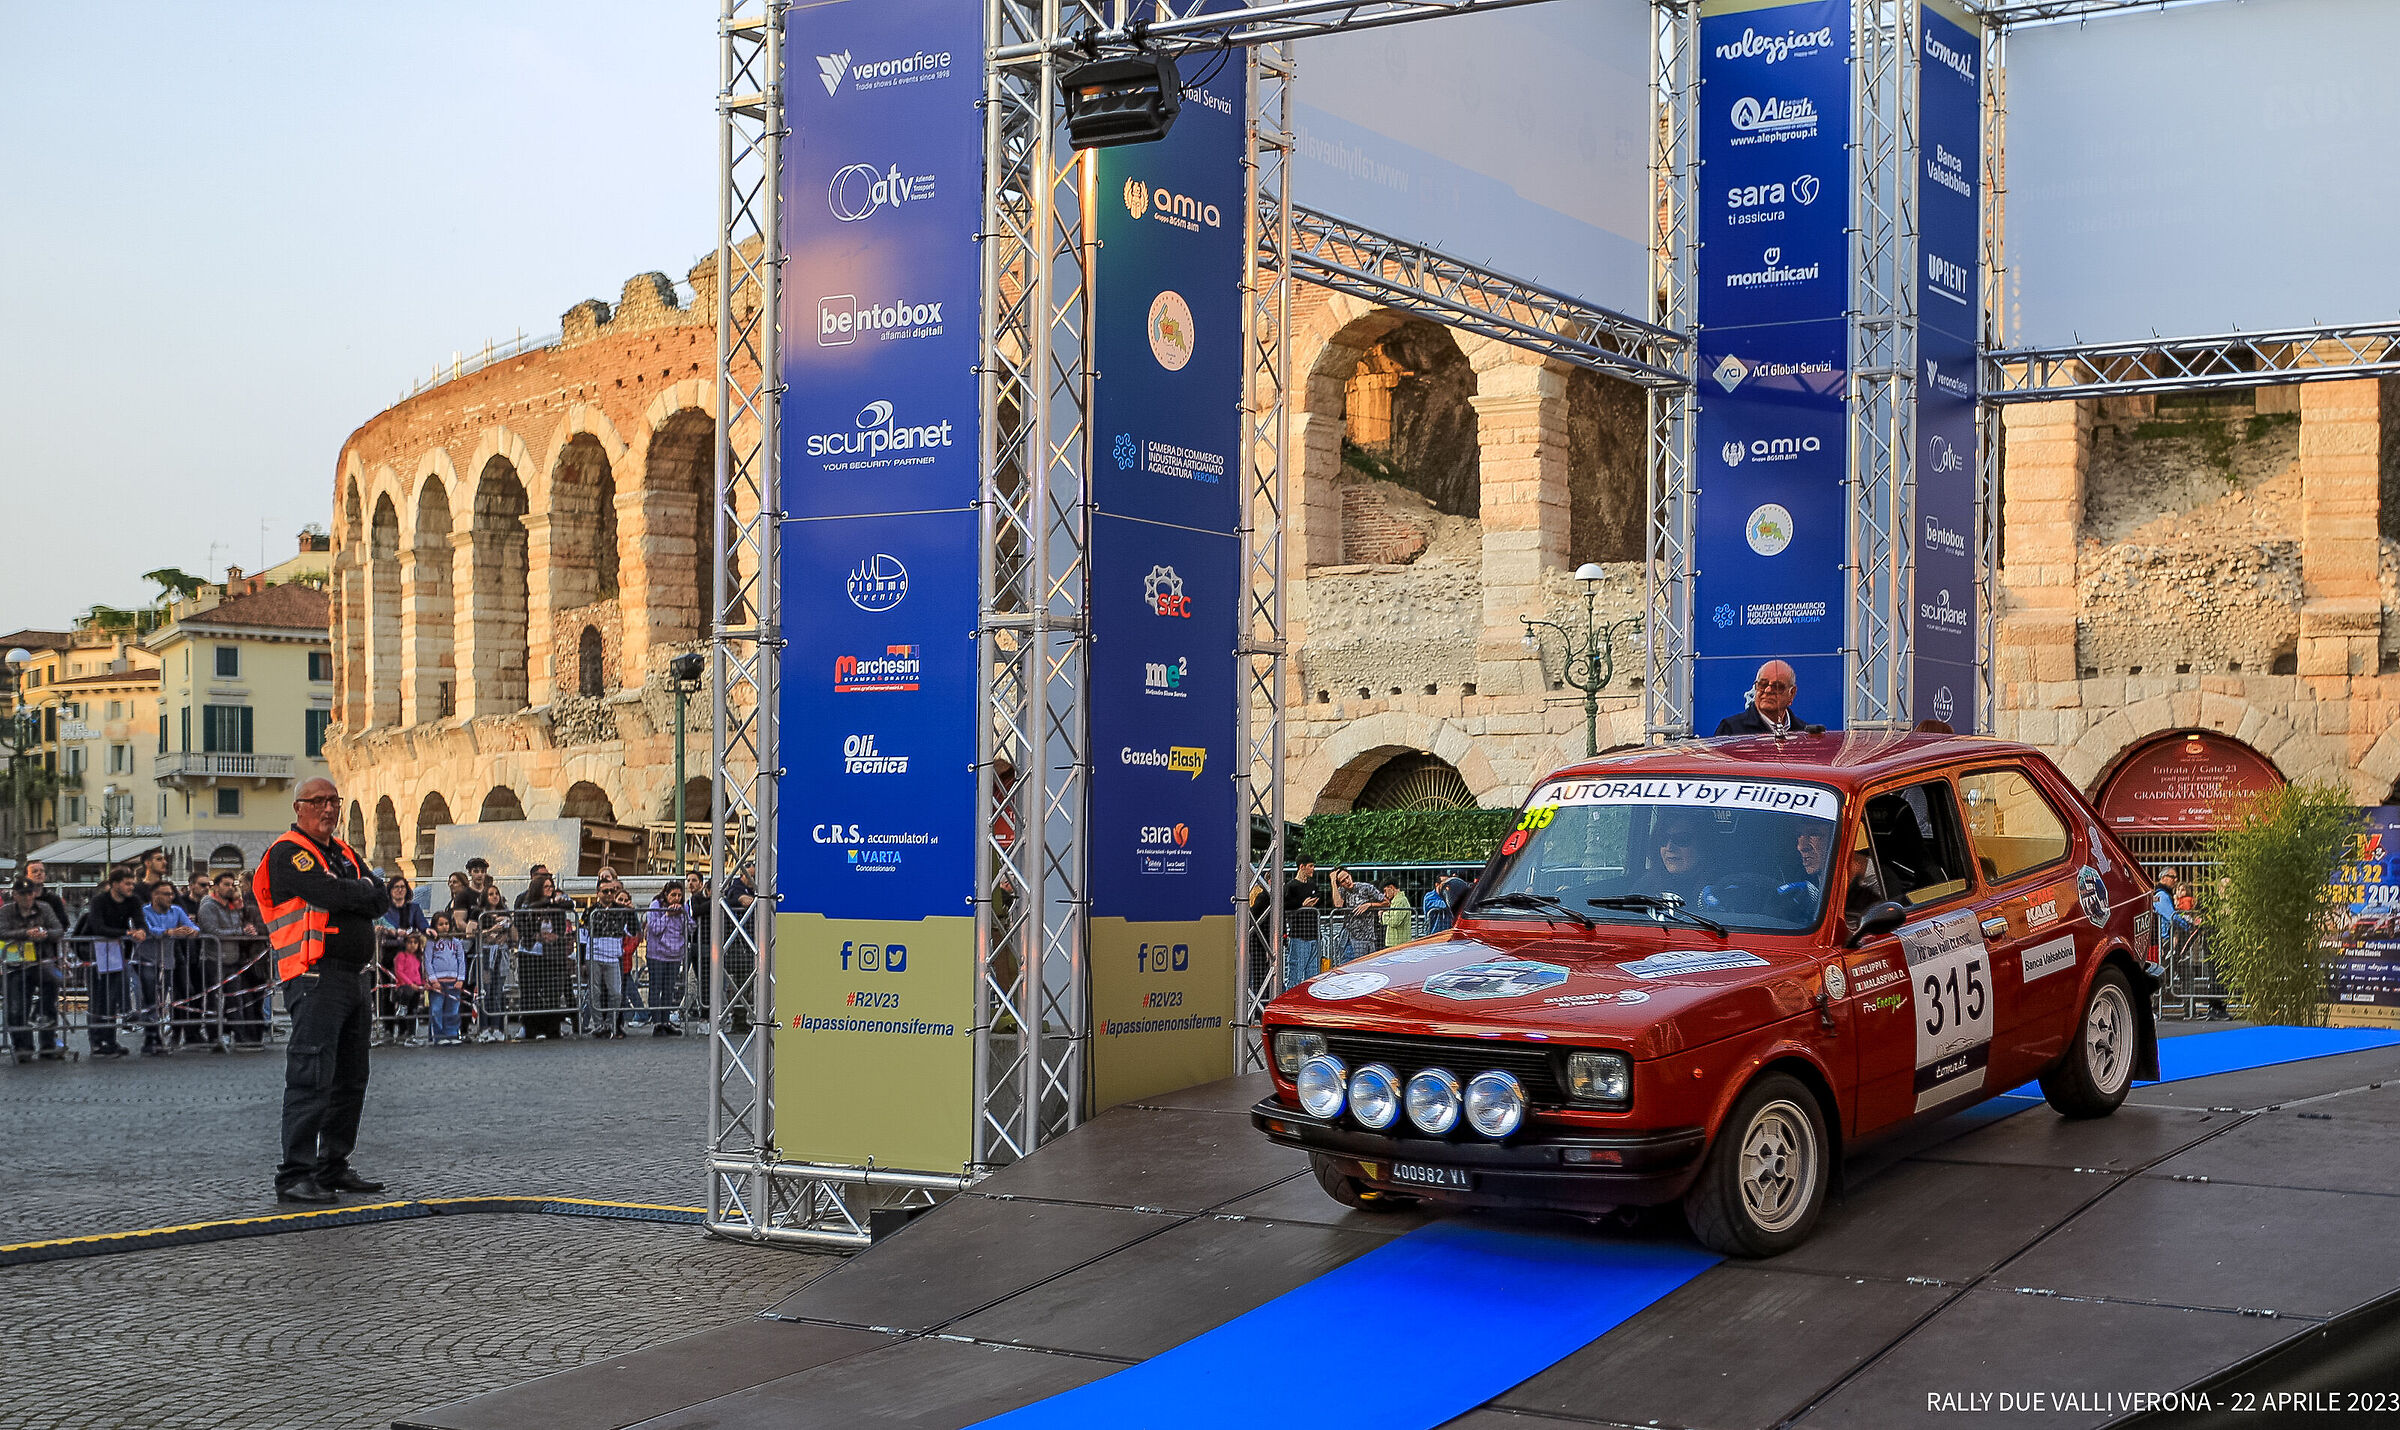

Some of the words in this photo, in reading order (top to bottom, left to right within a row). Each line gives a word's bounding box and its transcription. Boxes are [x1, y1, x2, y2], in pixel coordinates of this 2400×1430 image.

[1716, 26, 1832, 64] noleggiare
[1924, 29, 1975, 80] tomasi
[852, 51, 952, 80] veronafiere
[855, 83, 873, 91] Trade
[874, 80, 892, 89] shows
[899, 76, 919, 85] events
[919, 73, 936, 82] since
[1203, 90, 1232, 115] Servizi
[1760, 97, 1812, 120] Aleph
[1730, 127, 1818, 146] www.alephgroup.it
[1937, 143, 1962, 172] Banca
[872, 163, 914, 208] atv
[1927, 159, 1971, 198] Valsabbina
[1727, 183, 1785, 208] sara
[1153, 187, 1221, 229] amia
[1728, 213, 1736, 225] ti
[1738, 210, 1785, 224] assicura
[1727, 262, 1819, 287] mondinicavi
[1928, 253, 1967, 294] UPRENT
[821, 300, 943, 334] bentobox
[880, 330, 912, 341] affamati
[912, 325, 943, 340] digitali
[1752, 366, 1769, 378] ACI
[1770, 363, 1799, 376] Global
[1800, 359, 1832, 375] Servizi
[806, 416, 953, 458] sicurplanet
[1750, 436, 1821, 455] amia
[823, 462, 849, 472] YOUR
[849, 459, 893, 470] SECURITY
[893, 456, 936, 467] PARTNER
[1148, 440, 1177, 455] CAMERA
[1176, 446, 1185, 457] DI
[1184, 448, 1224, 465] COMMERCIO
[1148, 451, 1182, 467] INDUSTRIA
[1182, 457, 1224, 475] ARTIGIANATO
[1147, 462, 1193, 480] AGRICOLTURA
[1192, 471, 1219, 484] VERONA
[1926, 522, 1965, 549] bentobox
[1157, 592, 1192, 618] SEC
[1746, 603, 1775, 612] CAMERA
[1783, 602, 1826, 610] COMMERCIO
[1746, 610, 1782, 618] INDUSTRIA
[1782, 608, 1826, 617] ARTIGIANATO
[1920, 600, 1968, 627] sicurplanet
[1746, 616, 1793, 625] AGRICOLTURA
[1792, 616, 1821, 624] VERONA
[834, 655, 920, 684] Marchesini
[884, 674, 920, 682] GRAFICA
[843, 734, 878, 757] Oli.
[844, 756, 909, 774] Tecnica
[2153, 766, 2188, 775] Entrata
[2199, 765, 2223, 774] Gate
[2225, 764, 2237, 773] 23
[1546, 782, 1694, 802] AUTORALLY
[1694, 784, 1727, 804] by
[1733, 785, 1821, 809] Filippi
[2134, 790, 2196, 800] GRADINATA
[1516, 803, 1560, 831] 315
[812, 824, 865, 844] C.R.S.
[867, 831, 929, 845] accumulatori
[930, 835, 939, 845] srl
[1140, 825, 1172, 844] sara
[861, 850, 902, 863] VARTA
[855, 864, 896, 873] Concessionario
[2025, 899, 2057, 922] KART
[1860, 960, 1882, 976] FILIPPI
[2024, 959, 2044, 972] Banca
[2043, 946, 2074, 965] Valsabbina
[1862, 971, 1900, 989] MALASPINA
[846, 991, 900, 1009] #R2V23
[1142, 992, 1184, 1008] #R2V23
[1922, 959, 1986, 1036] 315
[792, 1013, 955, 1036] #lapassionenonsiferma
[1100, 1014, 1222, 1038] #lapassionenonsiferma
[1393, 1163, 1445, 1184] 400982
